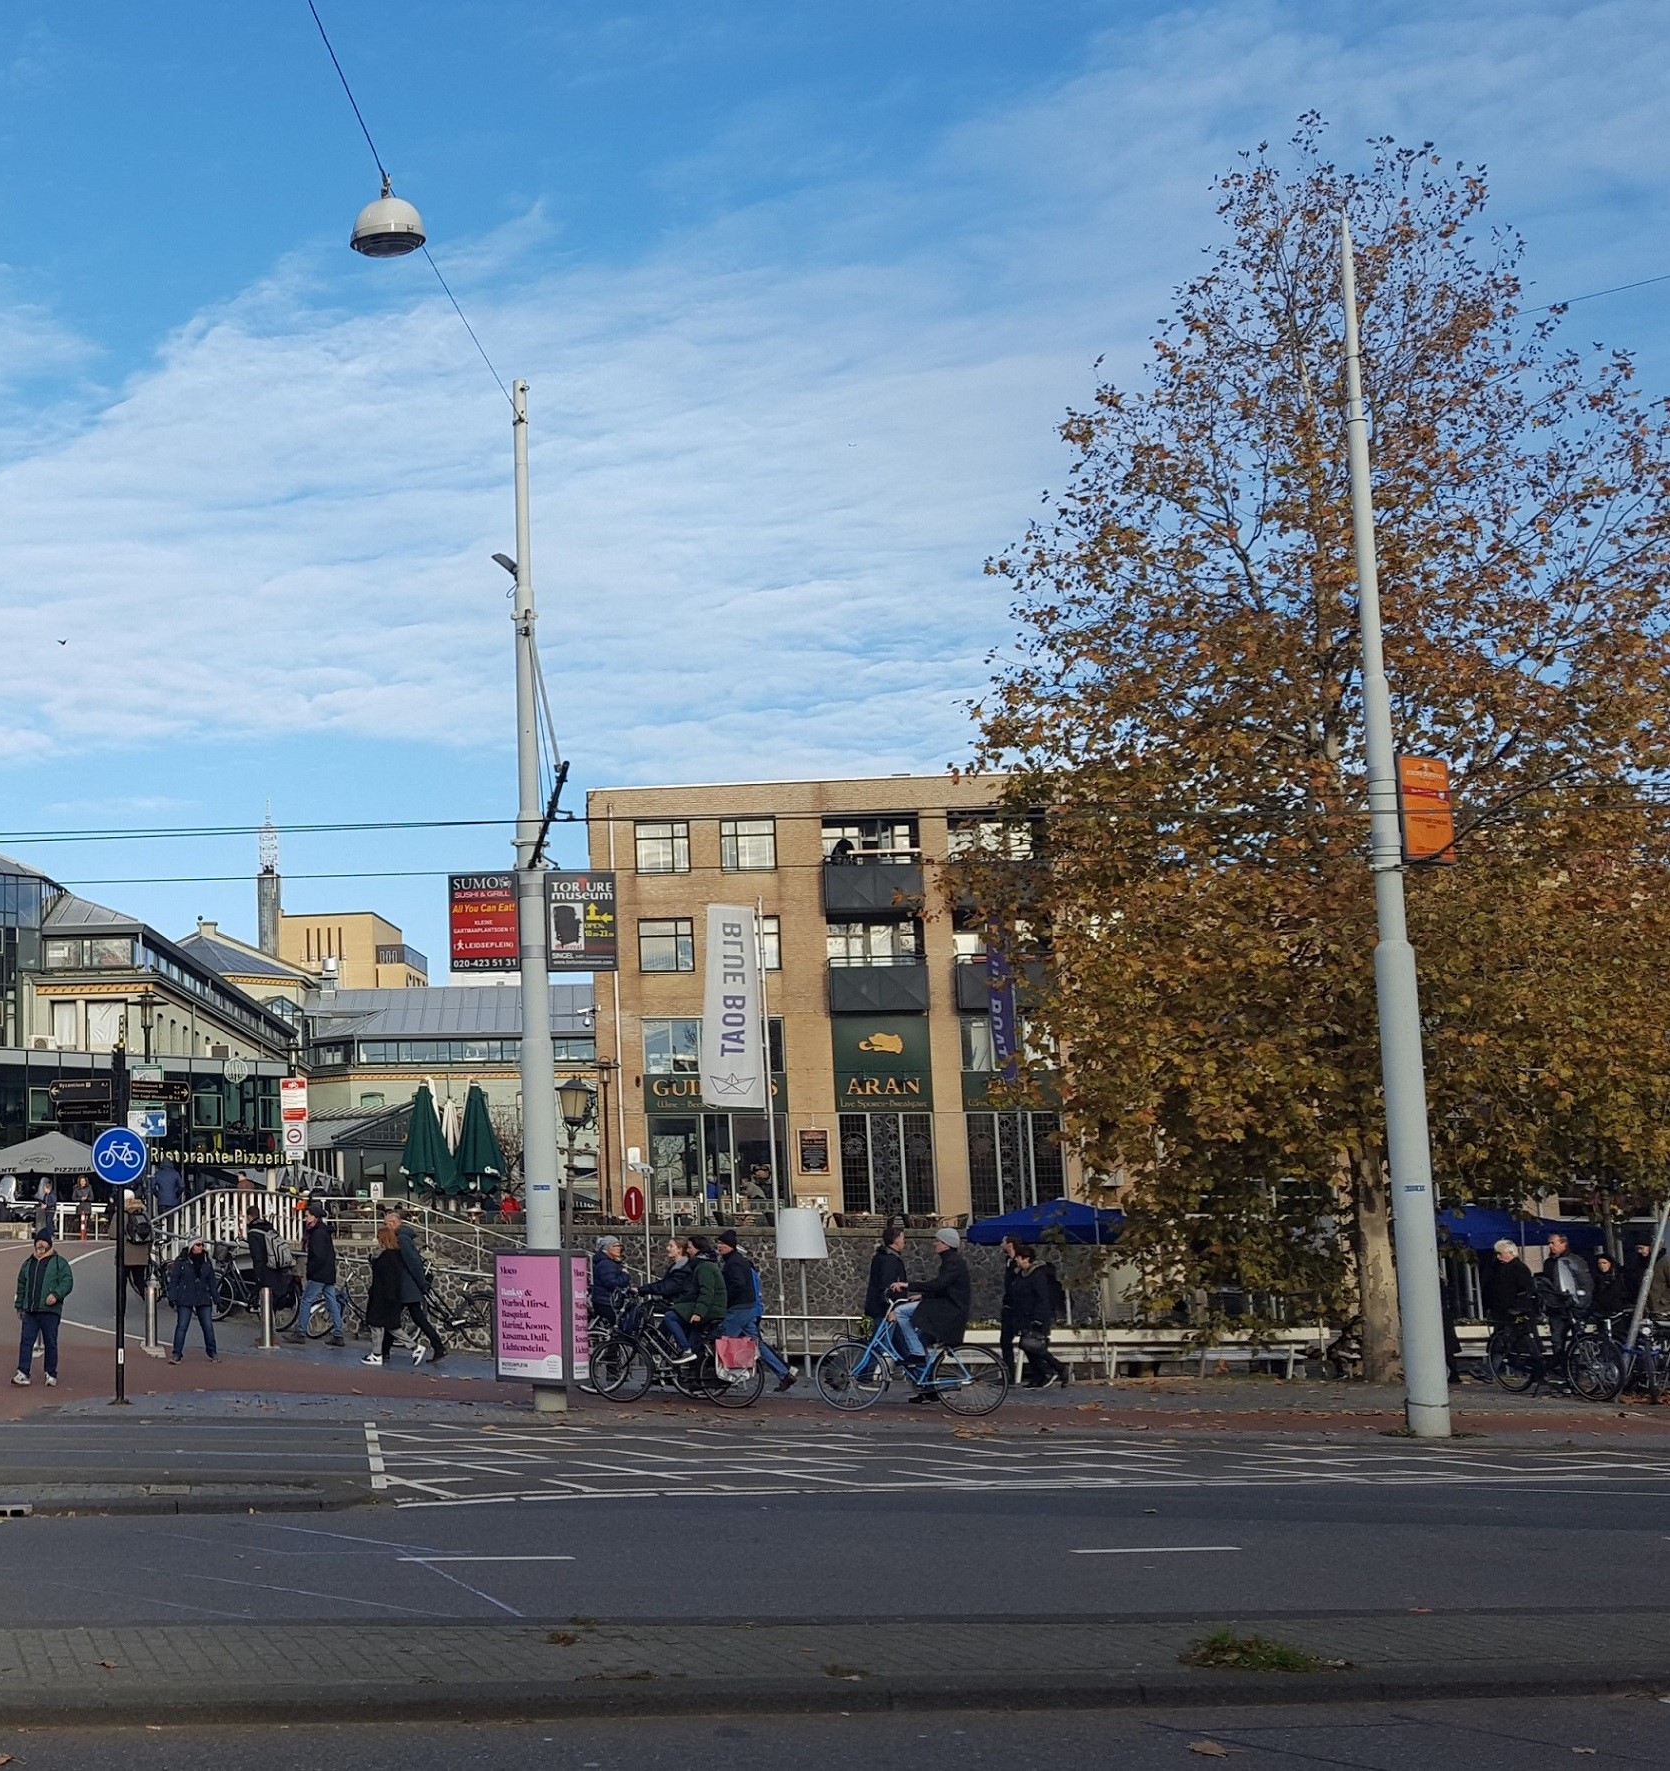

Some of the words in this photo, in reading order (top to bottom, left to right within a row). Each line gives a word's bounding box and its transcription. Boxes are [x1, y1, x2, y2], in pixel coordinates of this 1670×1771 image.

[453, 877, 499, 890] SUMO
[551, 875, 613, 893] TORTURE
[454, 891, 479, 899] SUSHI
[551, 891, 613, 900] museum
[452, 904, 464, 914] All
[464, 904, 479, 913] You
[480, 903, 497, 912] Can
[498, 902, 516, 912] Eat!
[453, 959, 490, 968] 020-423
[491, 958, 502, 967] 51
[505, 958, 517, 967] 31
[845, 1076, 922, 1095] ARAN
[150, 1147, 229, 1164] Ristorante
